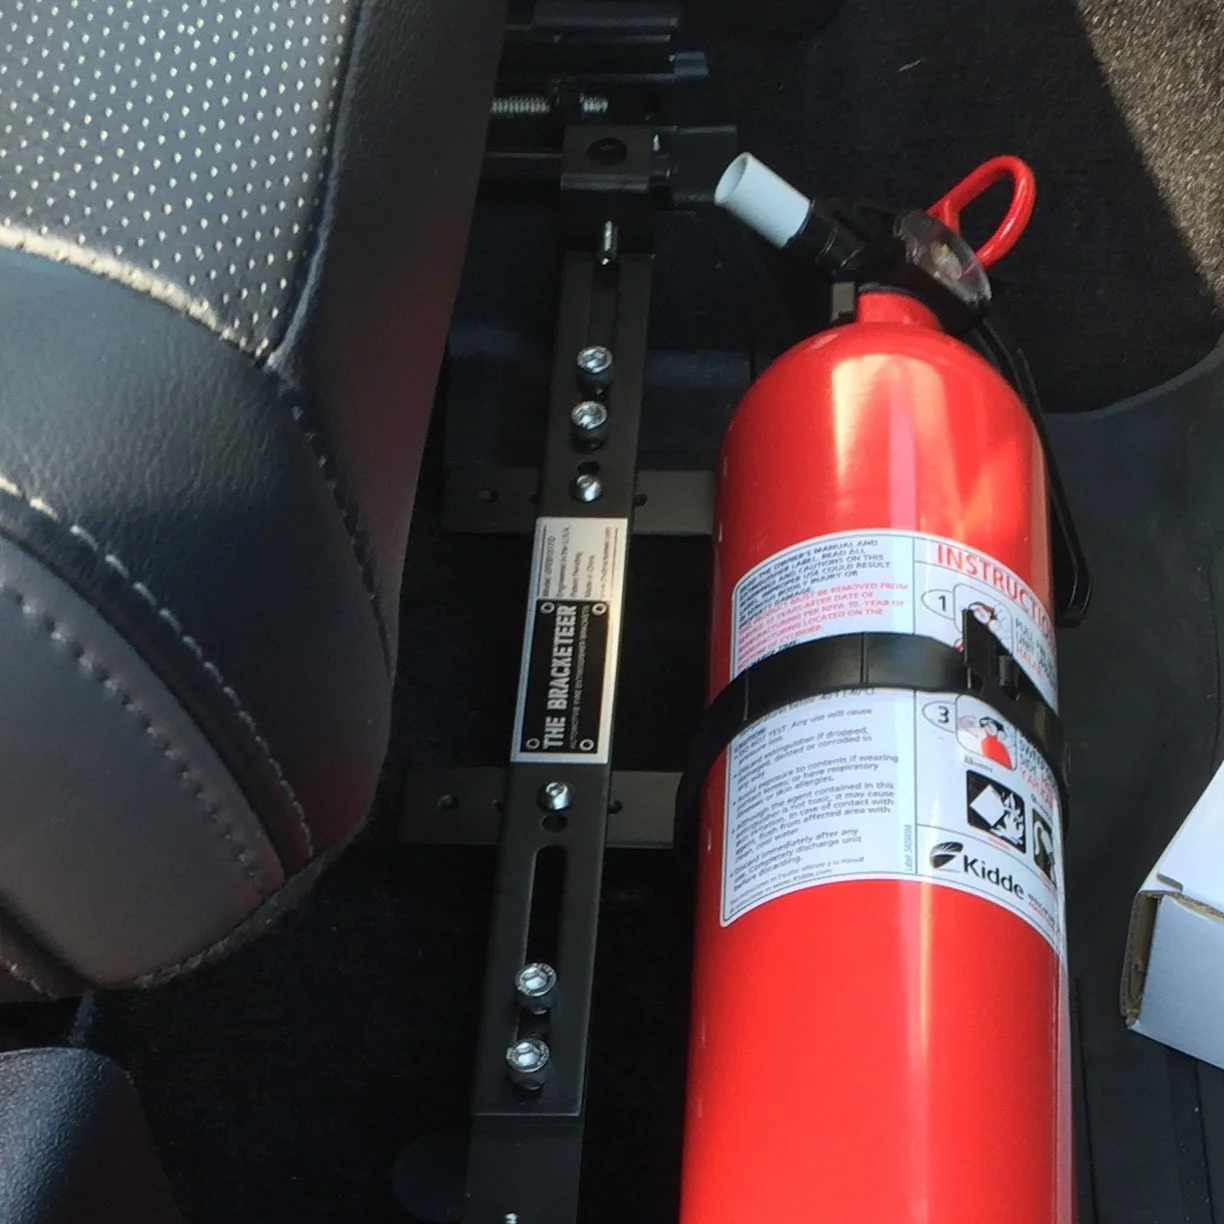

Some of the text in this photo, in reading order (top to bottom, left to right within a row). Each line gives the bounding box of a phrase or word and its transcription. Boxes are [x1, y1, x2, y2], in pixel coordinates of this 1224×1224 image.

[937, 544, 1055, 641] INSTRUCTIO
[938, 595, 947, 612] 1
[546, 604, 577, 709] BRACKETEER
[541, 716, 566, 749] THE
[937, 705, 949, 724] 3
[963, 854, 1025, 900] Kidde
